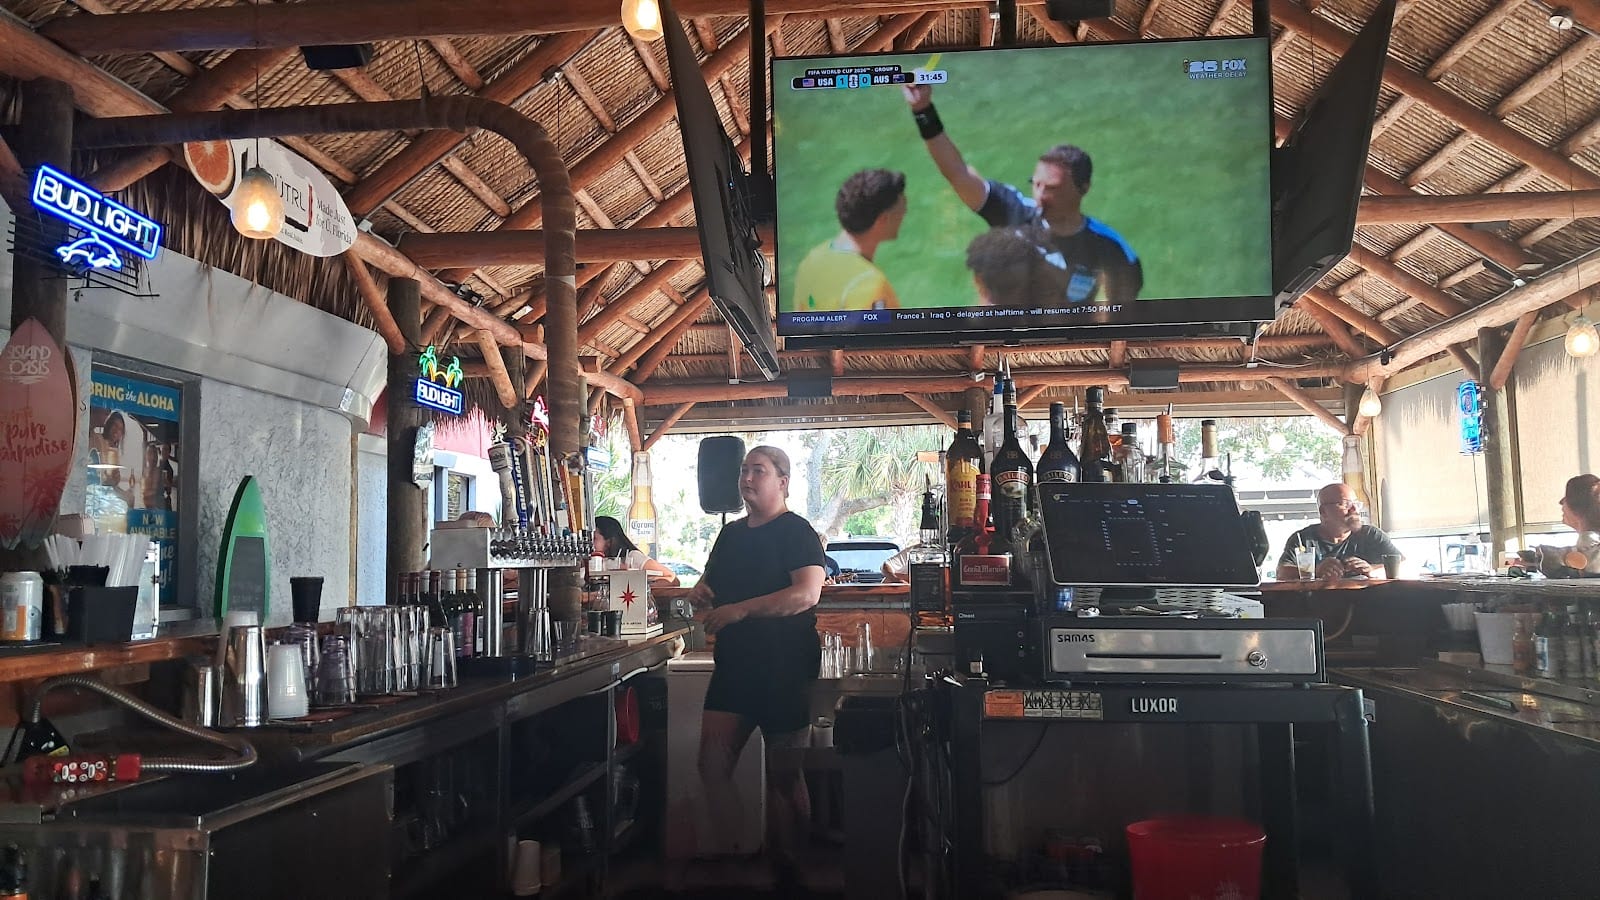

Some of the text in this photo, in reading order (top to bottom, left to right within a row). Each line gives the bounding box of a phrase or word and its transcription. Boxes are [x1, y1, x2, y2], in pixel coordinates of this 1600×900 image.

[1221, 59, 1247, 71] FOX
[817, 73, 943, 87] USA 1 0 AUS 31:45
[271, 173, 306, 212] ÜTRL
[39, 175, 154, 244] BUD LIGHT
[316, 199, 346, 226] Made Just
[332, 222, 352, 245] Florida
[792, 315, 825, 323] PROGRAM
[826, 314, 848, 322] ALERT
[863, 313, 878, 321] FOX
[896, 312, 920, 320] France
[930, 311, 944, 320] Iraq
[956, 309, 984, 319] delayed
[994, 308, 1024, 317] halftime
[1030, 307, 1043, 315] will
[1043, 307, 1071, 315] resume
[1071, 306, 1080, 314] at
[1081, 305, 1097, 313] 7:50
[1098, 305, 1111, 313] PM
[1112, 304, 1122, 312] ET
[7, 344, 52, 360] ISLAND
[9, 359, 50, 375] OASIS
[125, 390, 137, 402] the
[136, 391, 174, 412] ALOHA
[418, 383, 437, 402] BUD
[6, 421, 47, 449] pure
[142, 513, 164, 525] NW
[631, 520, 655, 530] Corona
[1131, 698, 1178, 713] LUXOR
